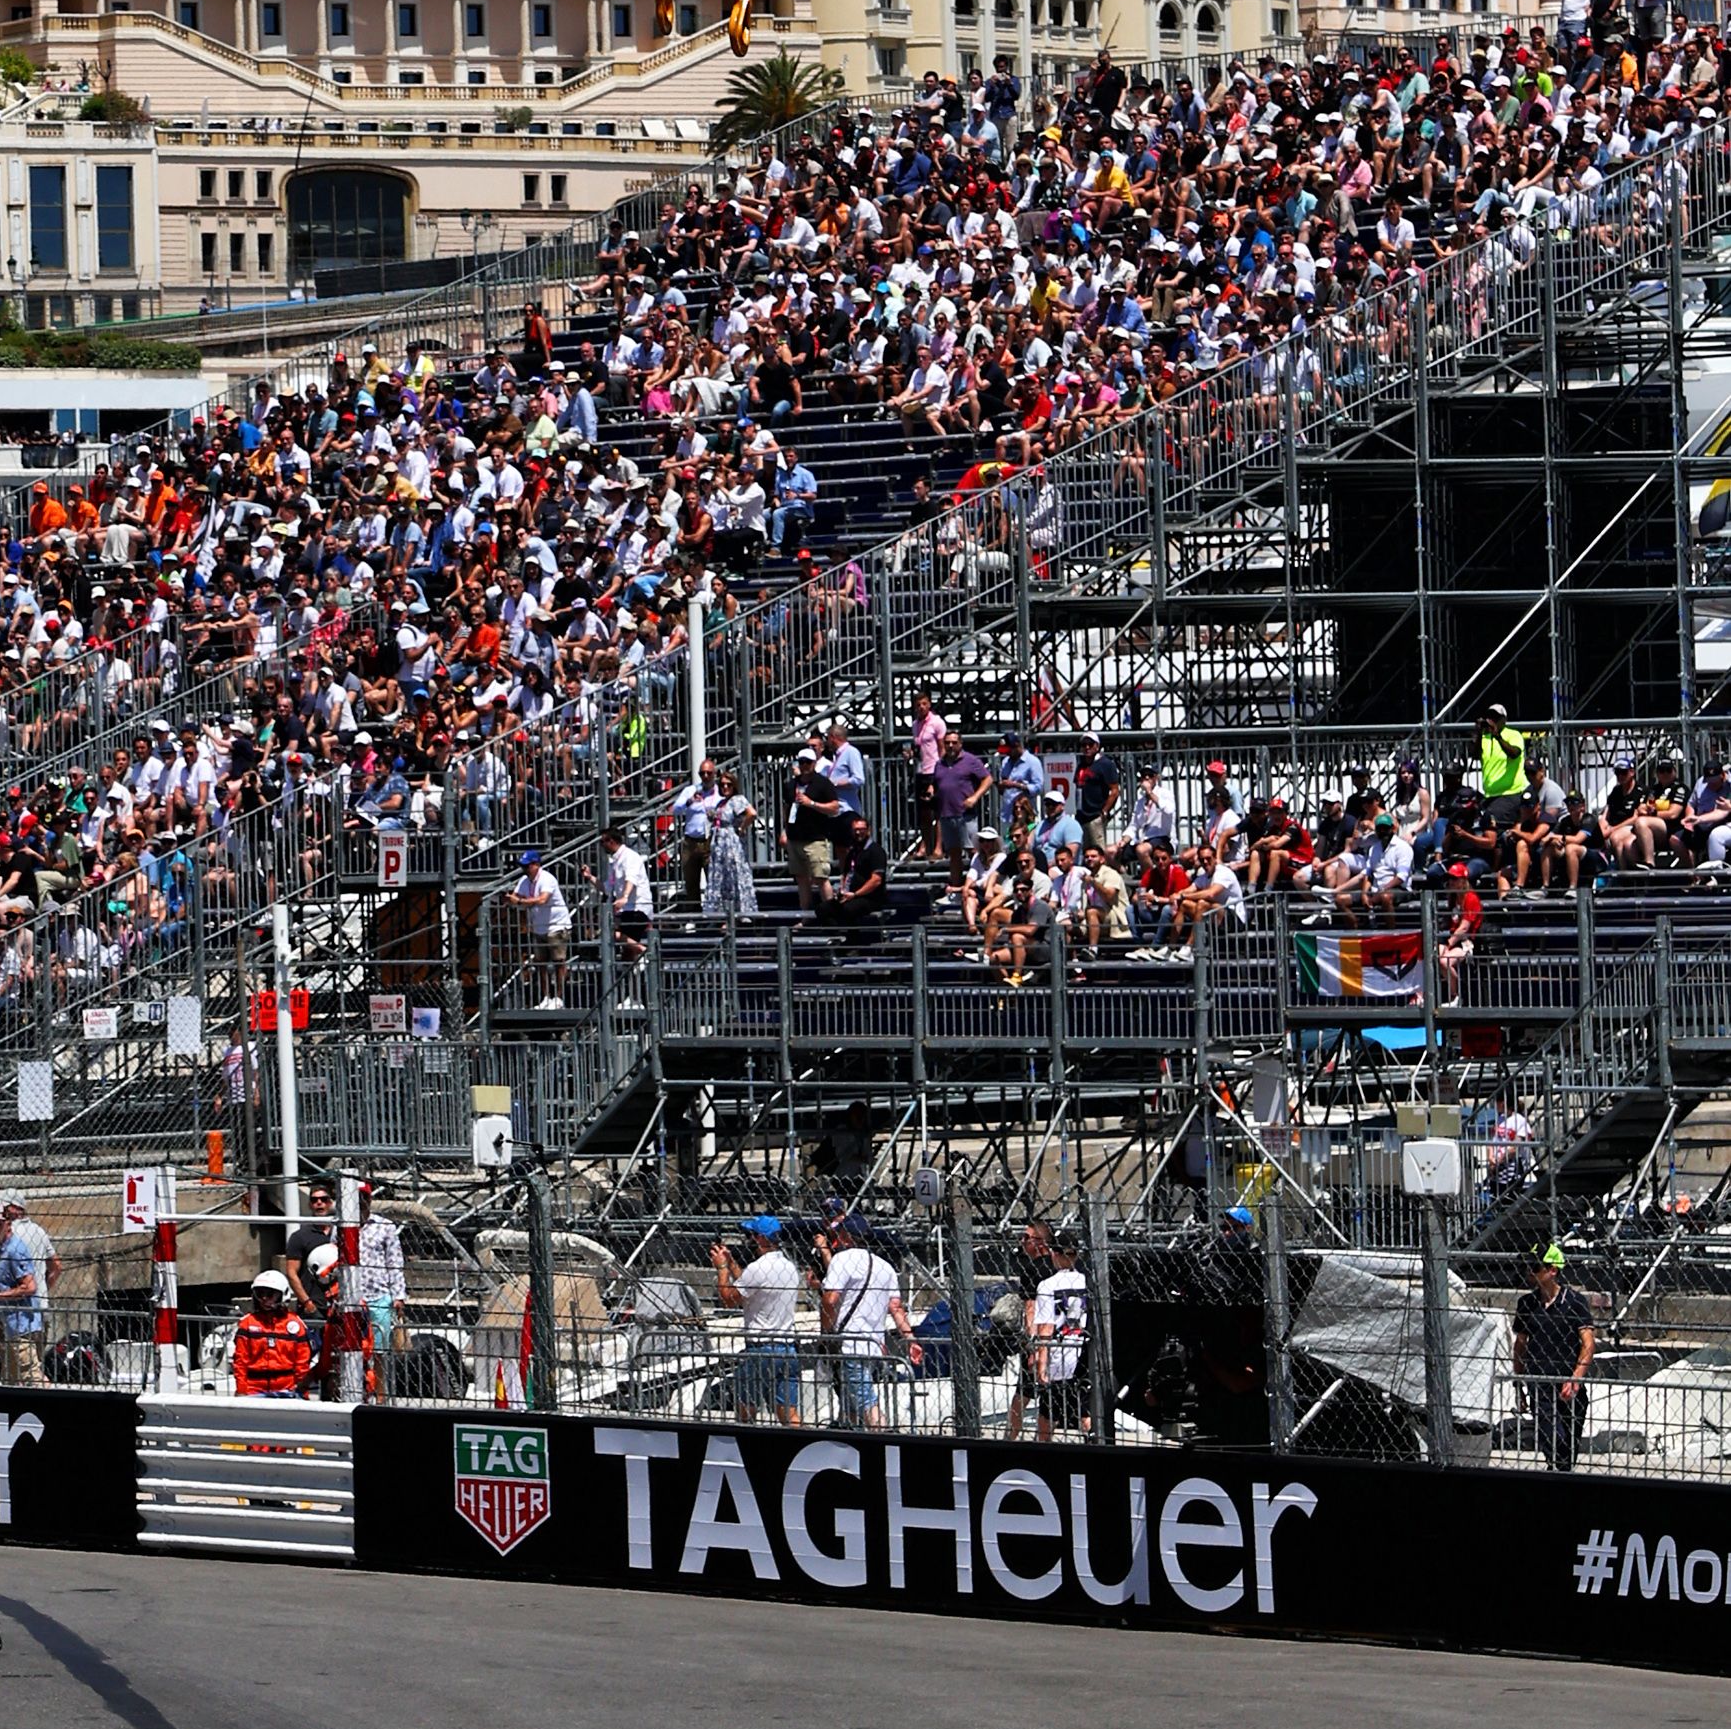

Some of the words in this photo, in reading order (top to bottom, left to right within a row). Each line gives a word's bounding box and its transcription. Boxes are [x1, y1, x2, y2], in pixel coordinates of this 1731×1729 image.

[384, 850, 401, 881] P
[395, 998, 404, 1010] P
[126, 1205, 150, 1213] FIRE
[461, 1430, 543, 1475] TAG
[455, 1479, 551, 1545] HEUER
[1573, 1529, 1731, 1604] #Mo
